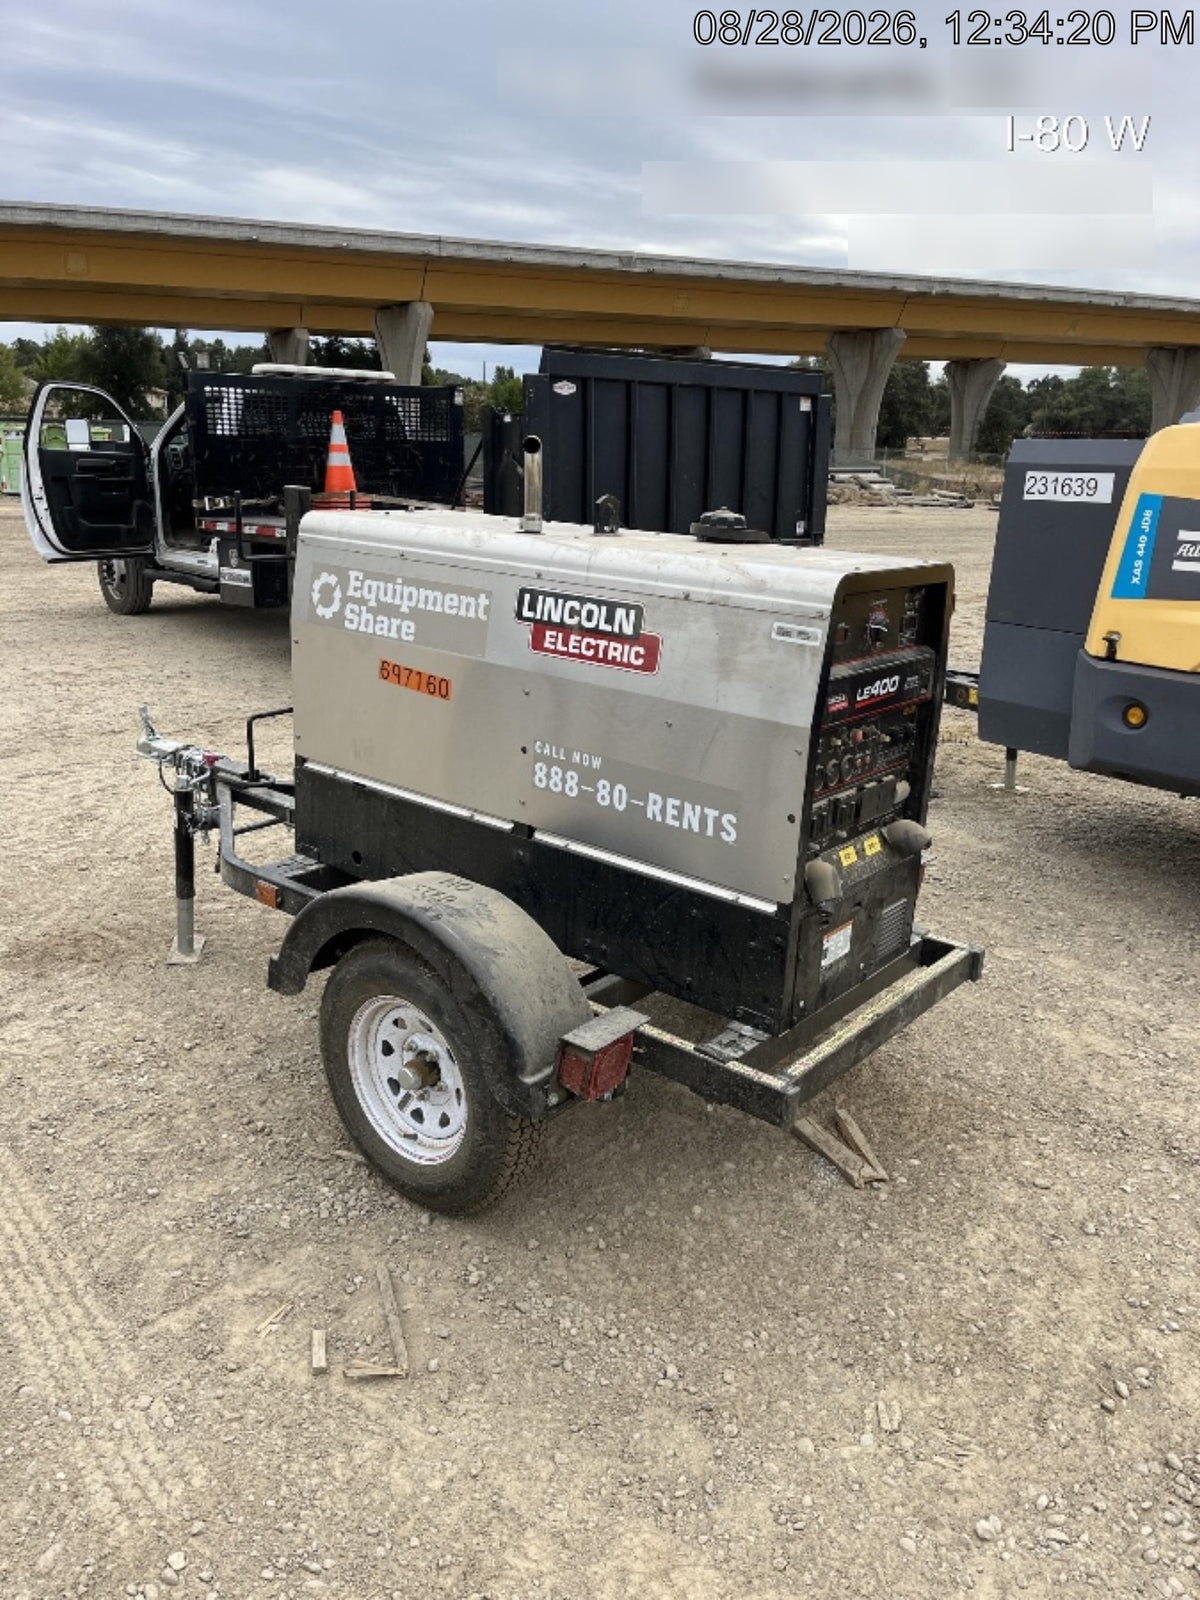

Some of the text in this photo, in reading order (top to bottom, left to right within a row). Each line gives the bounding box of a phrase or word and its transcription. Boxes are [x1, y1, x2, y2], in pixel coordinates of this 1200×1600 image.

[1025, 475, 1098, 498] 231639
[1130, 559, 1144, 585] XAS
[1137, 535, 1149, 558] 440
[346, 570, 490, 622] Equipment
[521, 592, 637, 636] LINCOLN
[343, 603, 416, 643] Share
[543, 630, 646, 666] ELECTRIC
[856, 674, 900, 703] LE400
[534, 739, 603, 770] CALL NOW
[532, 761, 738, 844] 888-80-RENTS
